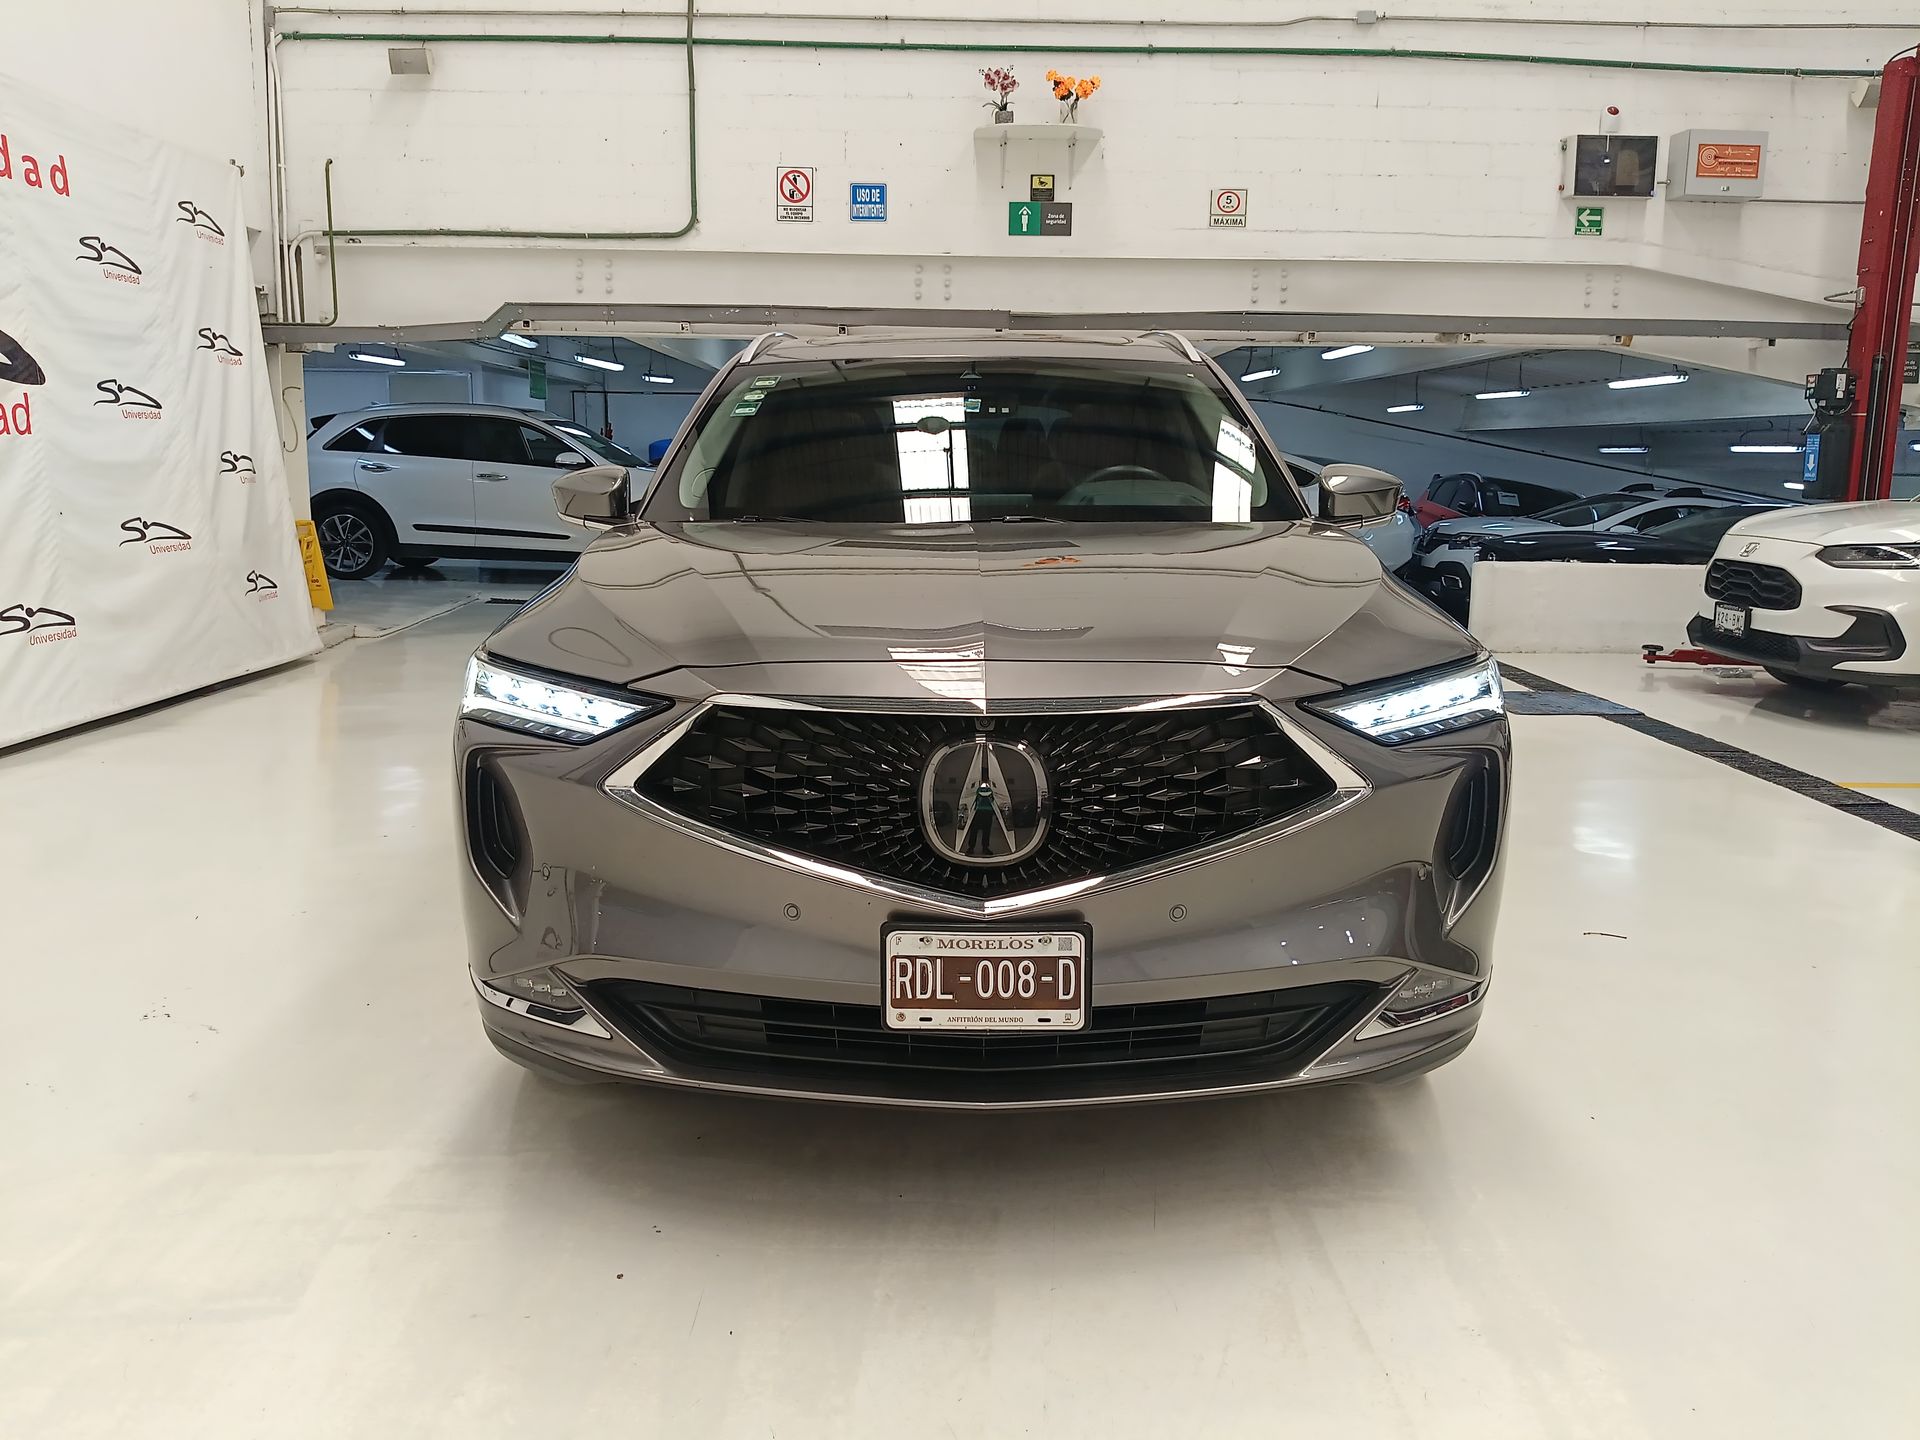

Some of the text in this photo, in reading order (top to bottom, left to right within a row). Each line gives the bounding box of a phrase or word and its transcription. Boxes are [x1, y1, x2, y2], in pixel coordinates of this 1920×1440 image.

[856, 188, 880, 202] USO DE
[1225, 195, 1232, 204] 5
[1213, 216, 1243, 226] MÁXIMA
[103, 269, 140, 285] Universidad
[121, 409, 162, 420] Universidad
[149, 541, 192, 555] Universidad
[29, 627, 77, 646] Universidad
[937, 938, 1034, 950] MORELOS
[947, 1015, 983, 1023] ANFITRIÓN
